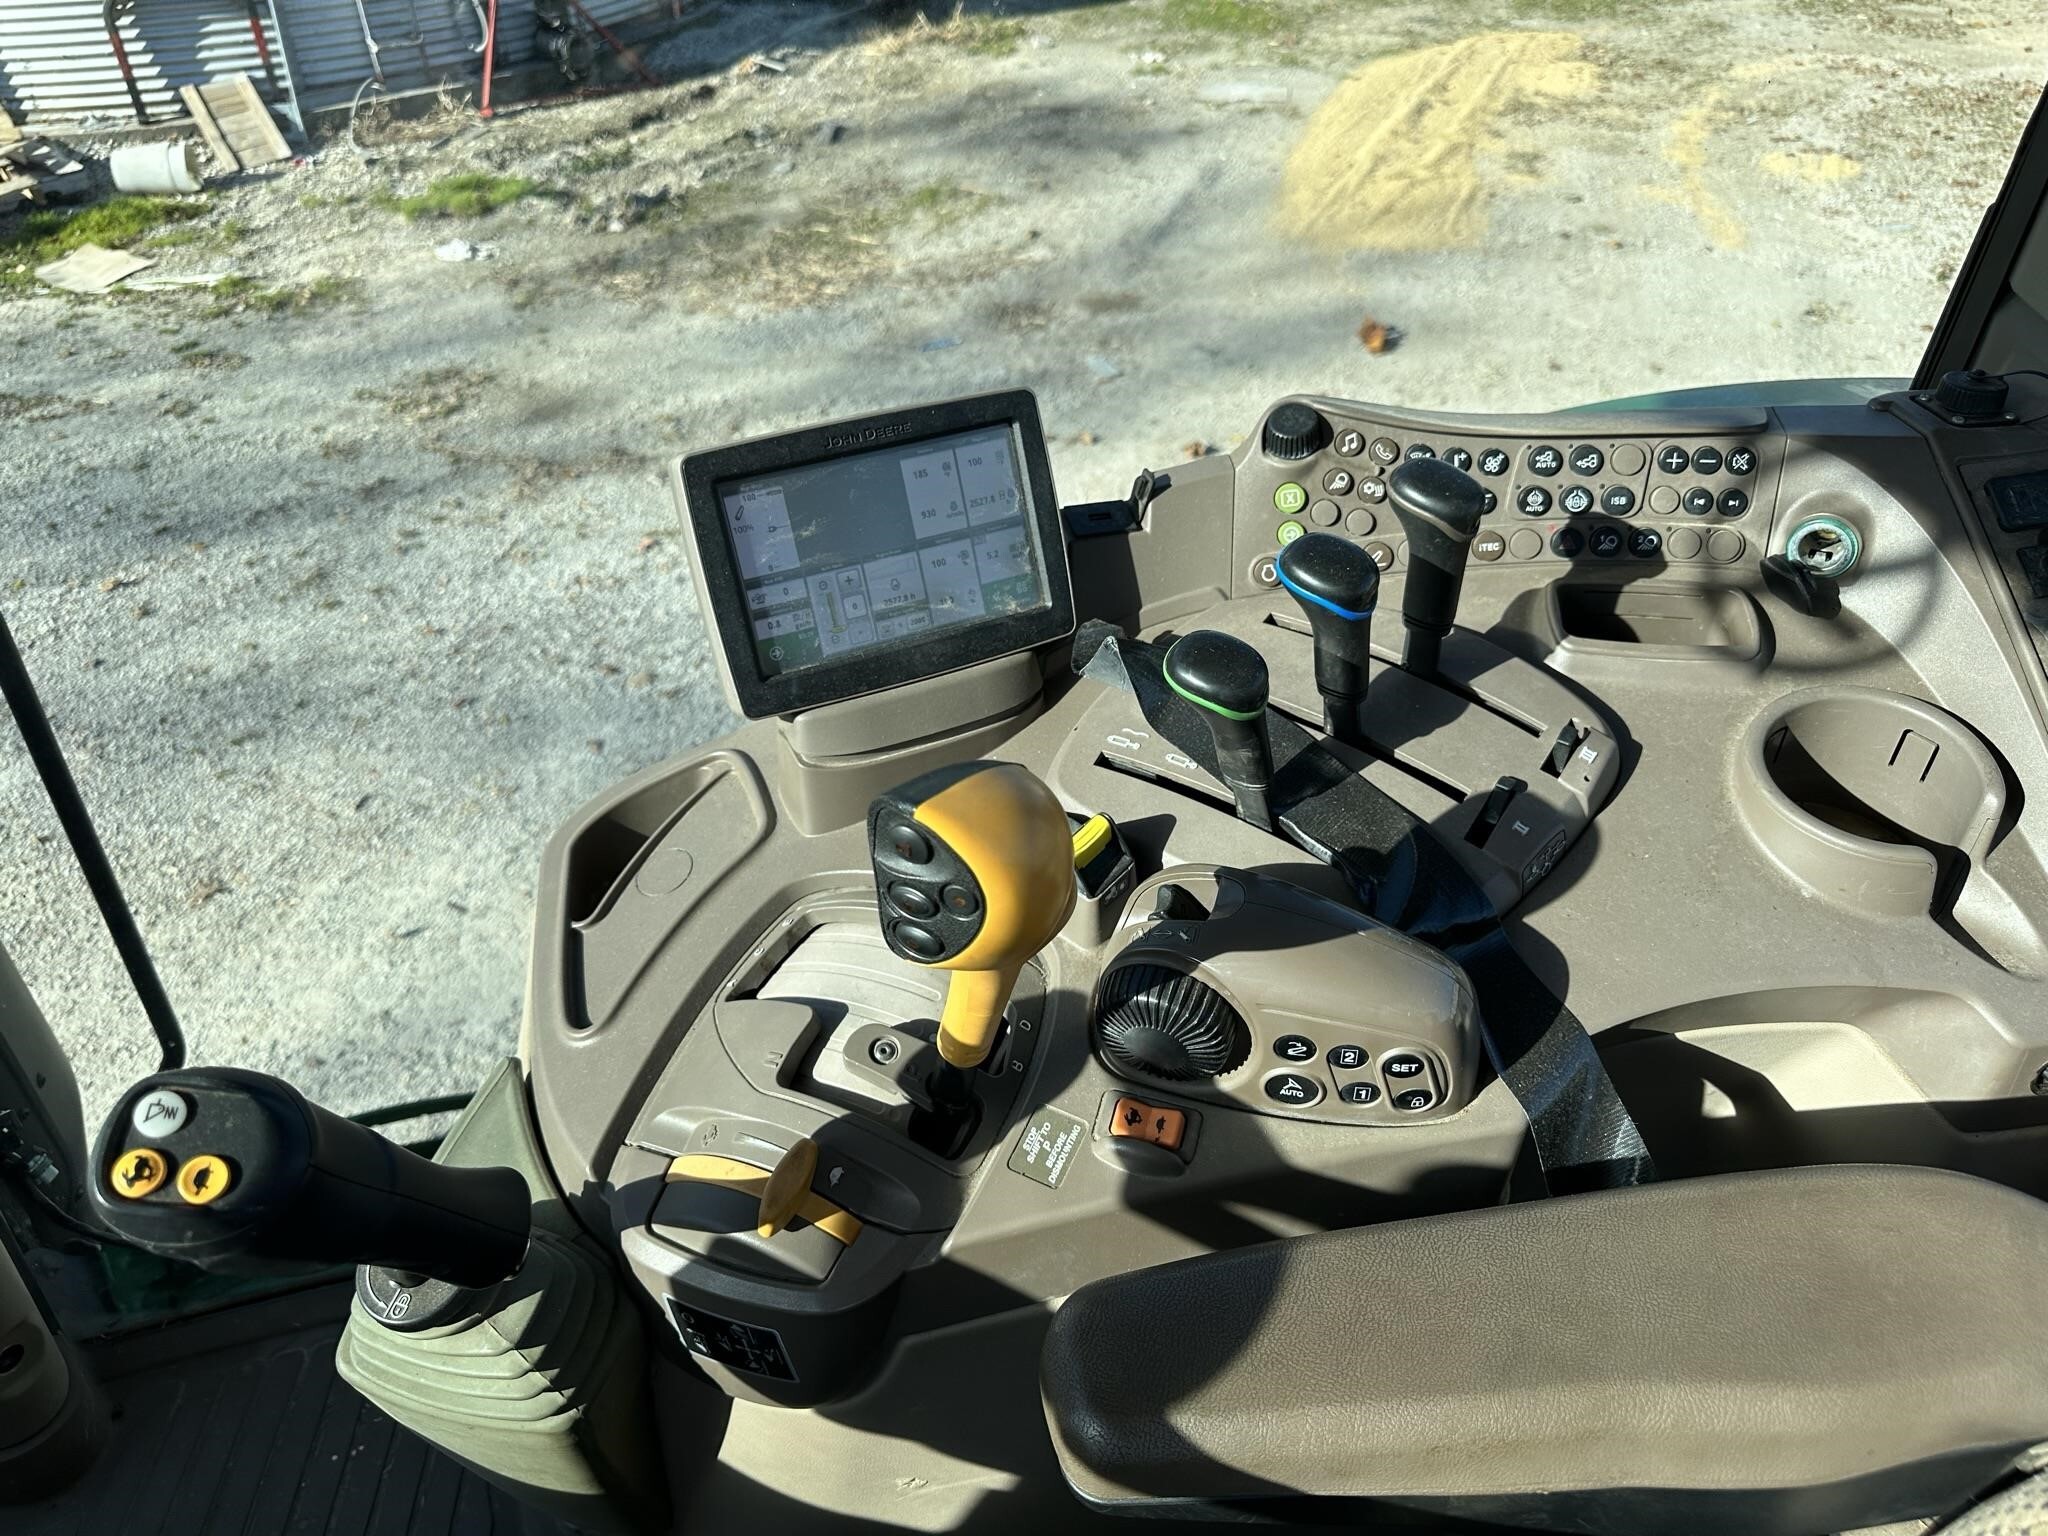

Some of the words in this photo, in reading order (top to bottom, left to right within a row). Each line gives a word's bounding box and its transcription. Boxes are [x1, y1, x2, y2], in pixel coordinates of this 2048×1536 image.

[825, 431, 863, 449] JOHN
[864, 422, 912, 441] DEERE
[1535, 461, 1557, 469] AUTO
[1019, 1019, 1031, 1031] D
[1343, 1051, 1355, 1063] 2
[1391, 1063, 1419, 1073] SET
[1279, 1088, 1304, 1098] AUTO
[1358, 1089, 1367, 1099] 1
[1022, 1126, 1037, 1152] STOP
[1027, 1134, 1044, 1164] SHIFT
[1040, 1122, 1051, 1136] TO
[1042, 1140, 1052, 1152] P
[1045, 1131, 1068, 1169] BEFORE
[1048, 1124, 1081, 1184] DISMOUNTING
